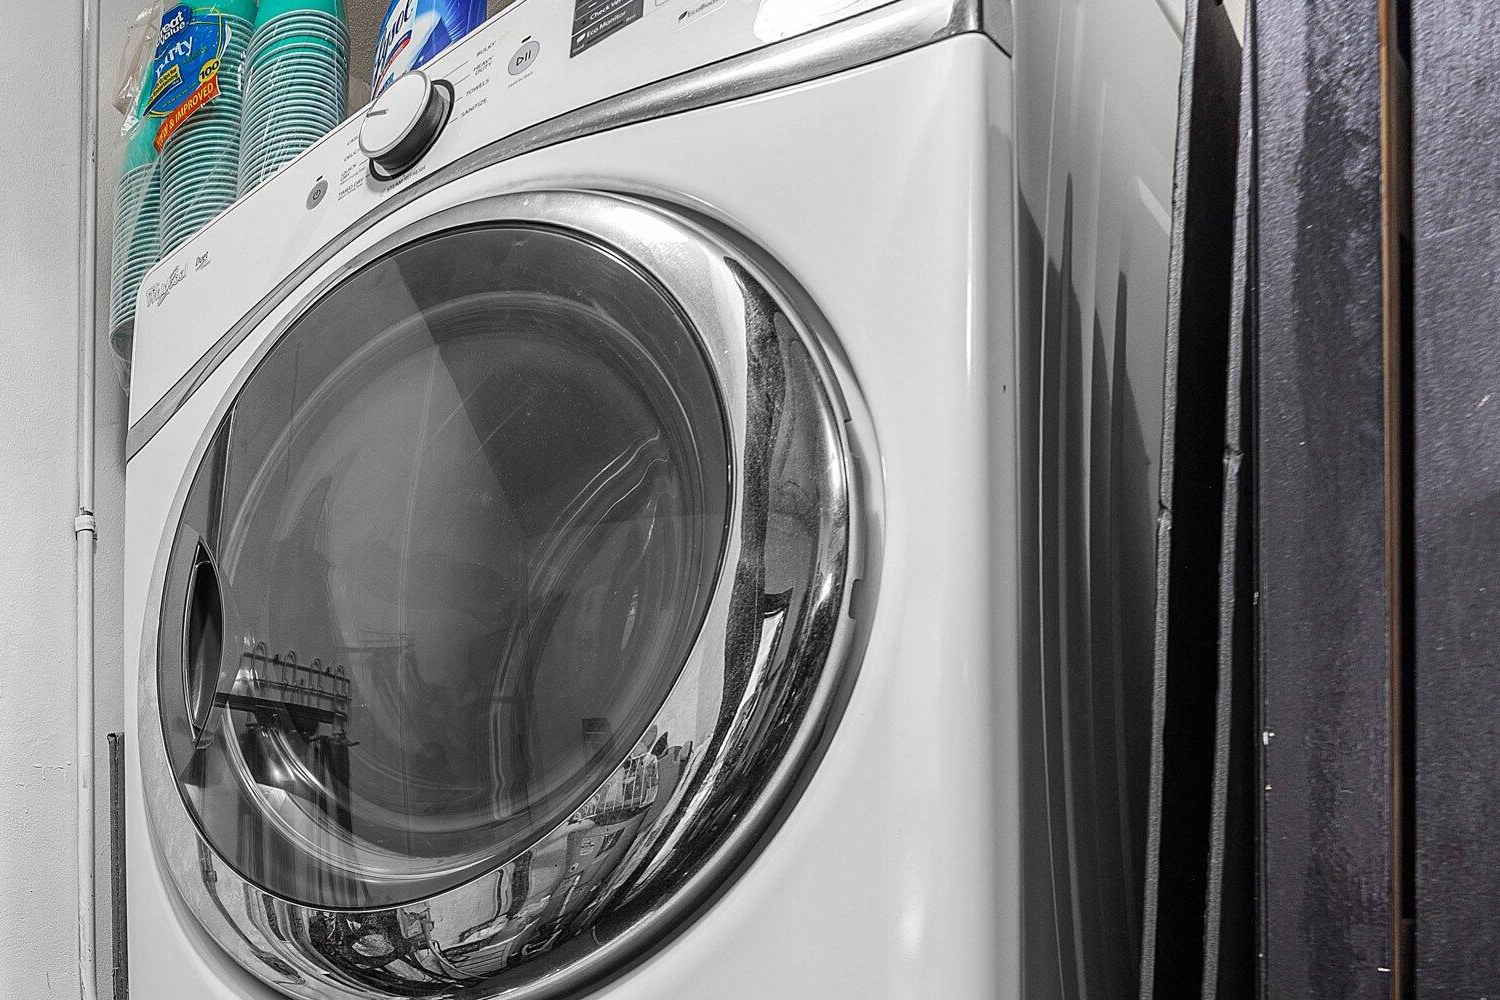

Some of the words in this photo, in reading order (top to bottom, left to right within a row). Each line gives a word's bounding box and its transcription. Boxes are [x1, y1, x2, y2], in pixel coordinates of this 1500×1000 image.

[586, 28, 598, 37] Eco
[599, 10, 626, 29] Monitor
[200, 60, 219, 80] 100
[466, 79, 490, 96] TOWELS
[169, 118, 176, 130] &
[175, 83, 214, 121] IMPROVED
[461, 97, 488, 117] SANITIZE
